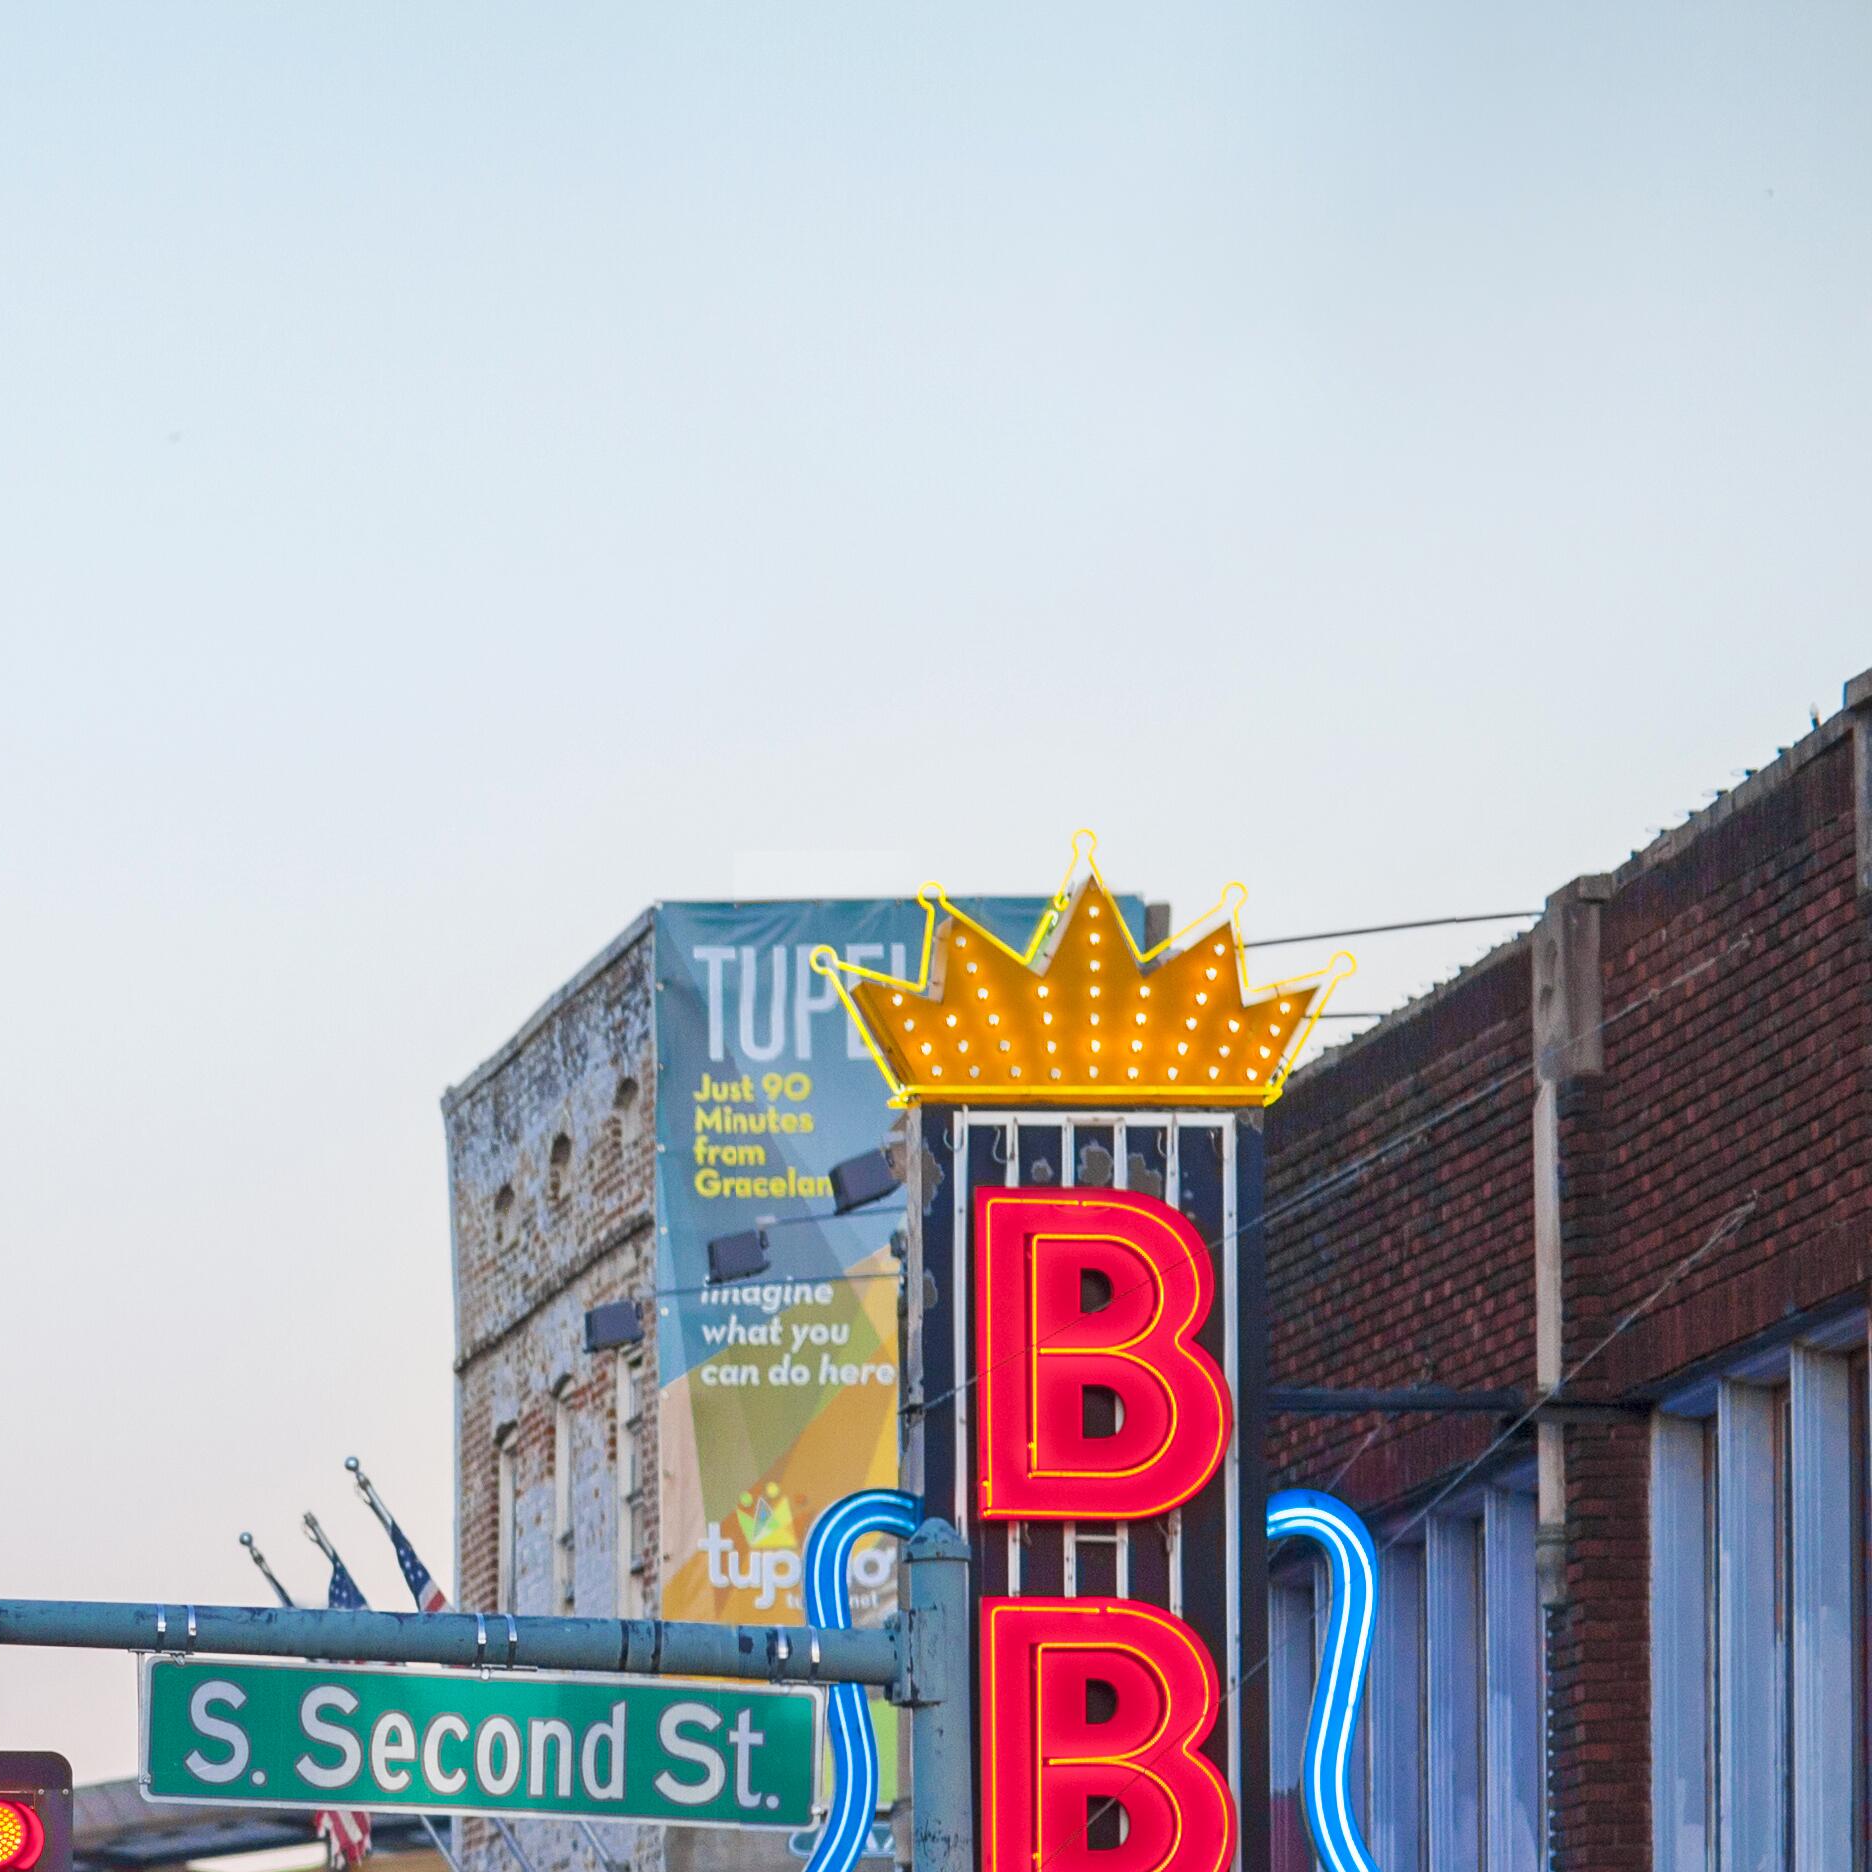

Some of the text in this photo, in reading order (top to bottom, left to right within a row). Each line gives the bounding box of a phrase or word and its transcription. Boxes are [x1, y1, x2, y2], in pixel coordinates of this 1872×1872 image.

[694, 944, 906, 1062] TUPE
[693, 1072, 812, 1102] Just 90
[693, 1105, 814, 1134] Minutes
[693, 1136, 766, 1167] from
[693, 1167, 833, 1199] Gracelan
[701, 1276, 834, 1313] imagine
[702, 1314, 850, 1352] what you
[700, 1353, 897, 1387] can do here
[697, 1521, 897, 1610] tupo
[185, 1679, 781, 1811] S. Second St.
